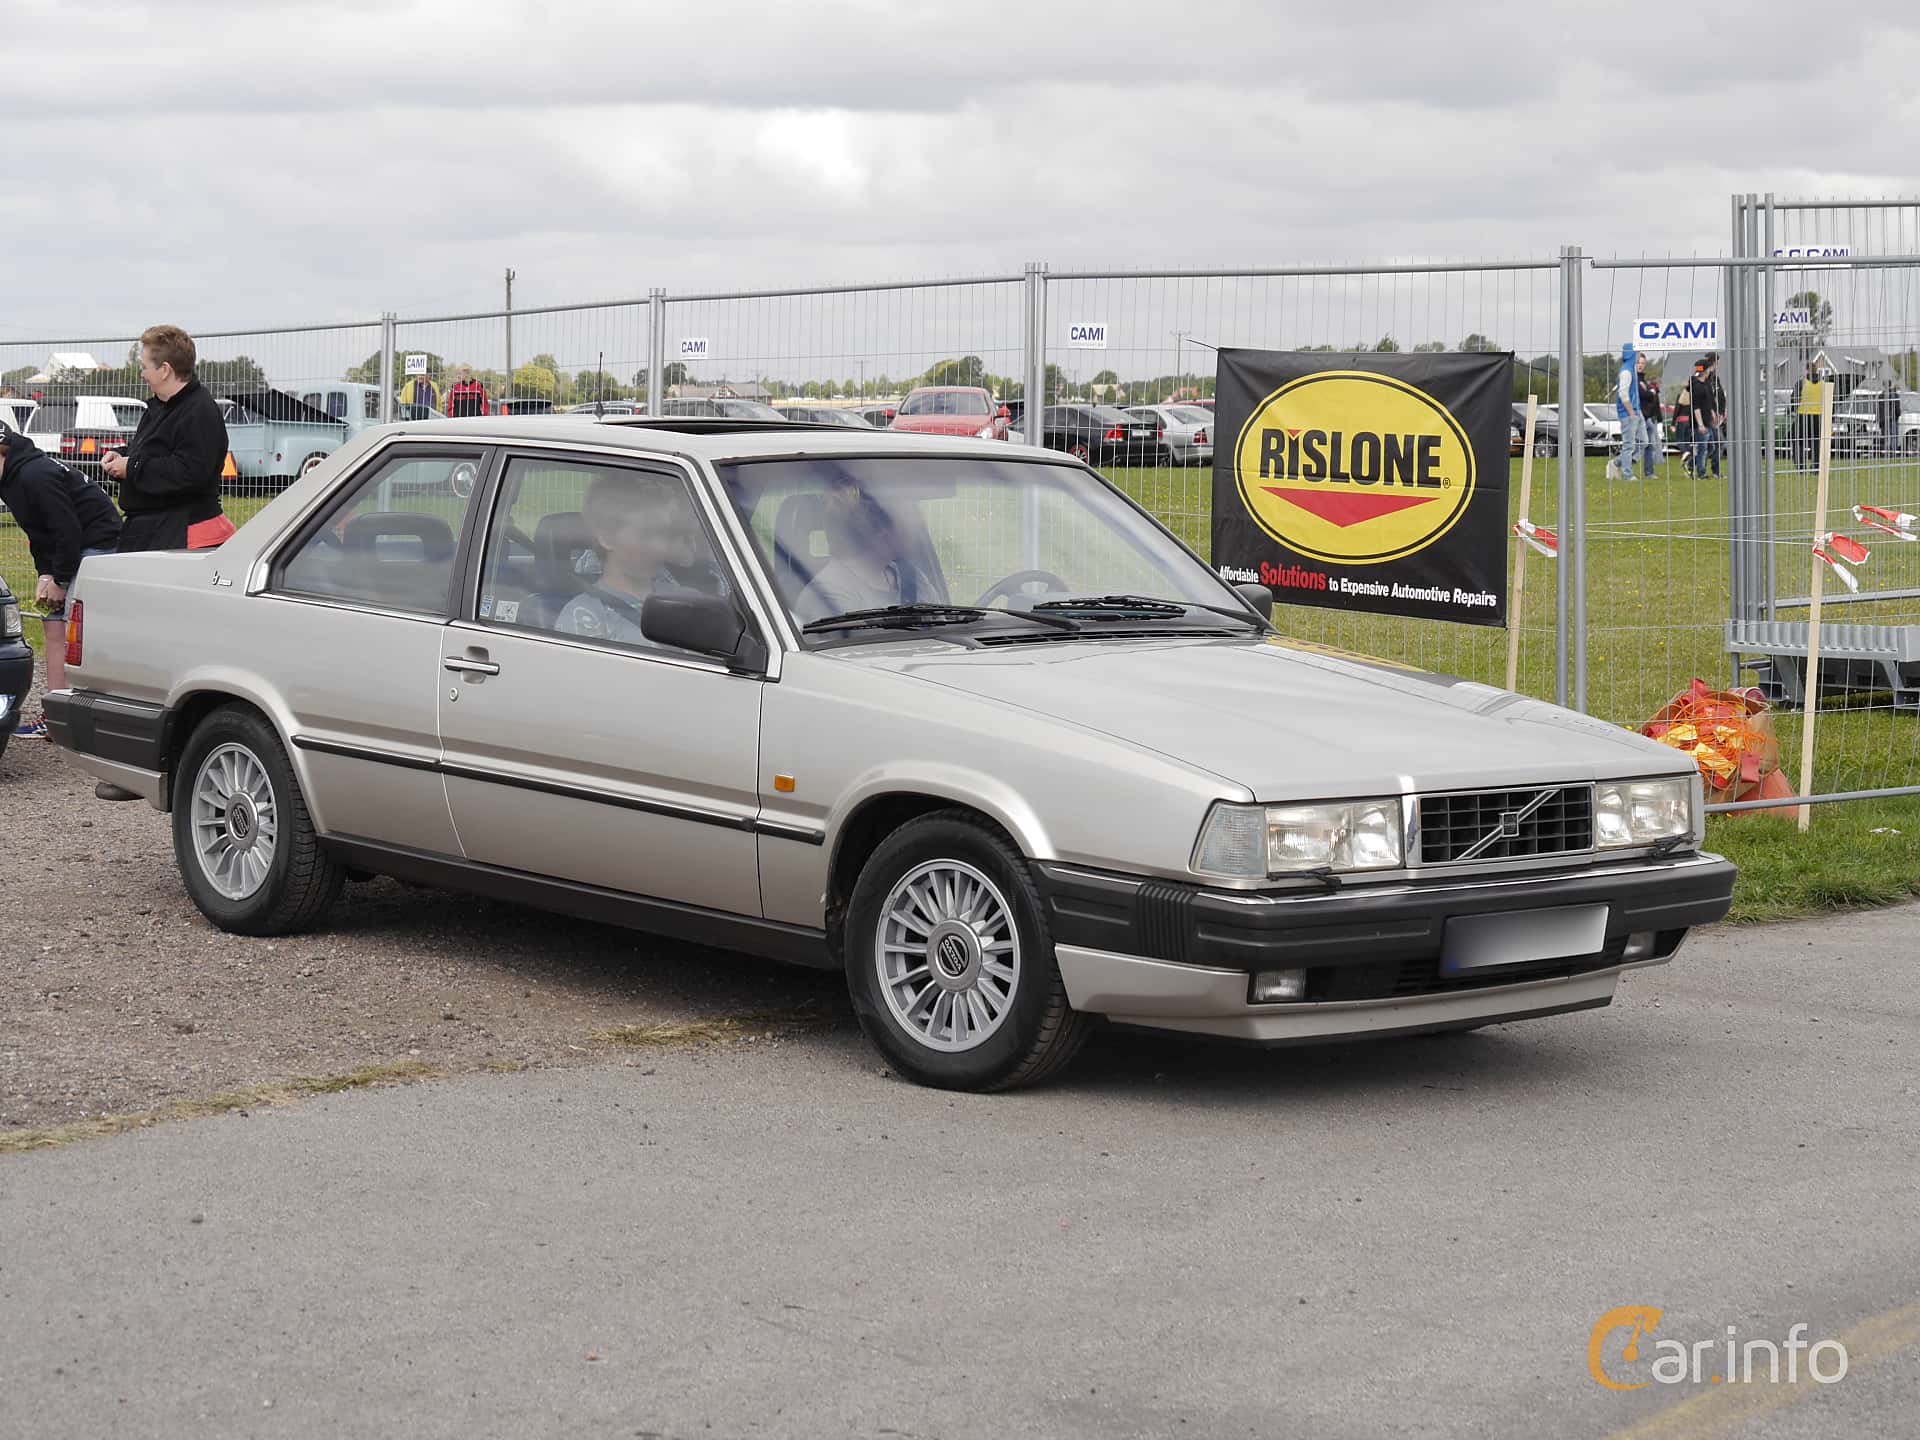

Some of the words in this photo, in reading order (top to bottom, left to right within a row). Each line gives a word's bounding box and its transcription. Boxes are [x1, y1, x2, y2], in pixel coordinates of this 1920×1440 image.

[1071, 326, 1104, 341] CAMI
[1639, 321, 1716, 339] CAMI
[681, 341, 706, 353] CAMI
[407, 358, 425, 369] CAMI
[1260, 561, 1326, 591] Solutions
[1328, 577, 1339, 592] to
[1340, 577, 1389, 597] Expensive
[1391, 582, 1450, 603] Automotive
[1453, 588, 1497, 608] Repairs
